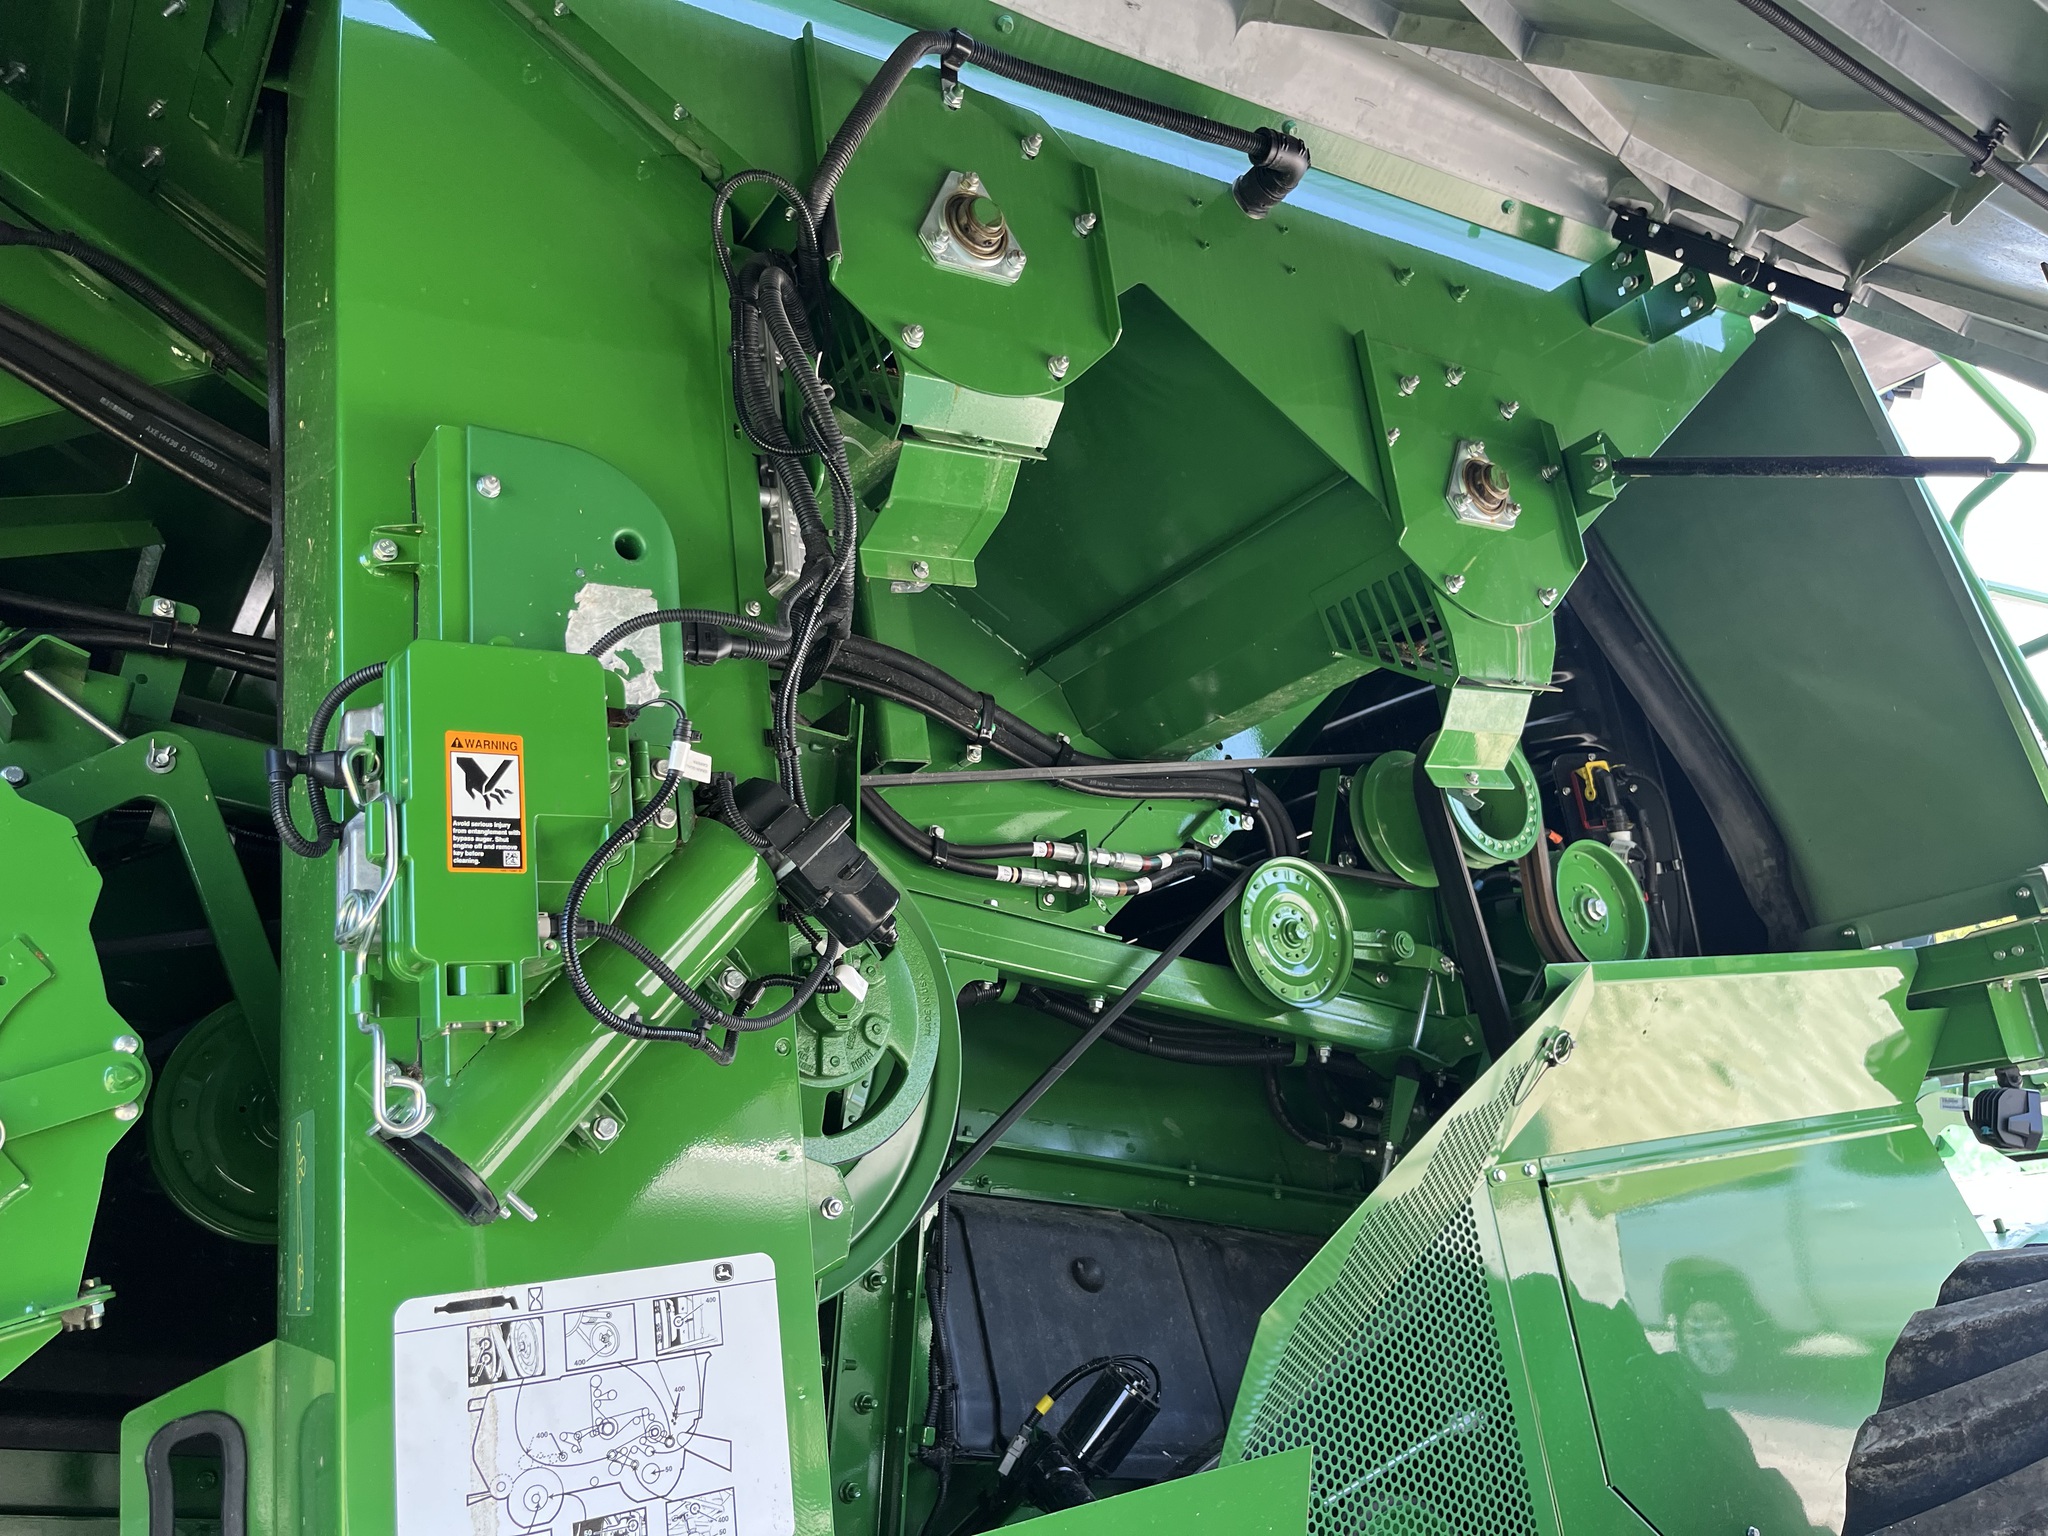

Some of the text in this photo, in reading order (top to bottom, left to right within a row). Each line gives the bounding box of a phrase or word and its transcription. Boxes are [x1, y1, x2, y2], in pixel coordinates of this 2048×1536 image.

[465, 739, 518, 751] WARNING
[493, 821, 511, 830] injury
[468, 828, 508, 836] entanglement
[453, 835, 475, 843] bypass
[475, 836, 495, 844] auger.
[453, 857, 481, 866] cleaning.
[674, 1385, 686, 1393] 400
[536, 1431, 548, 1439] 400
[665, 1465, 673, 1473] 50
[717, 1515, 730, 1523] 400
